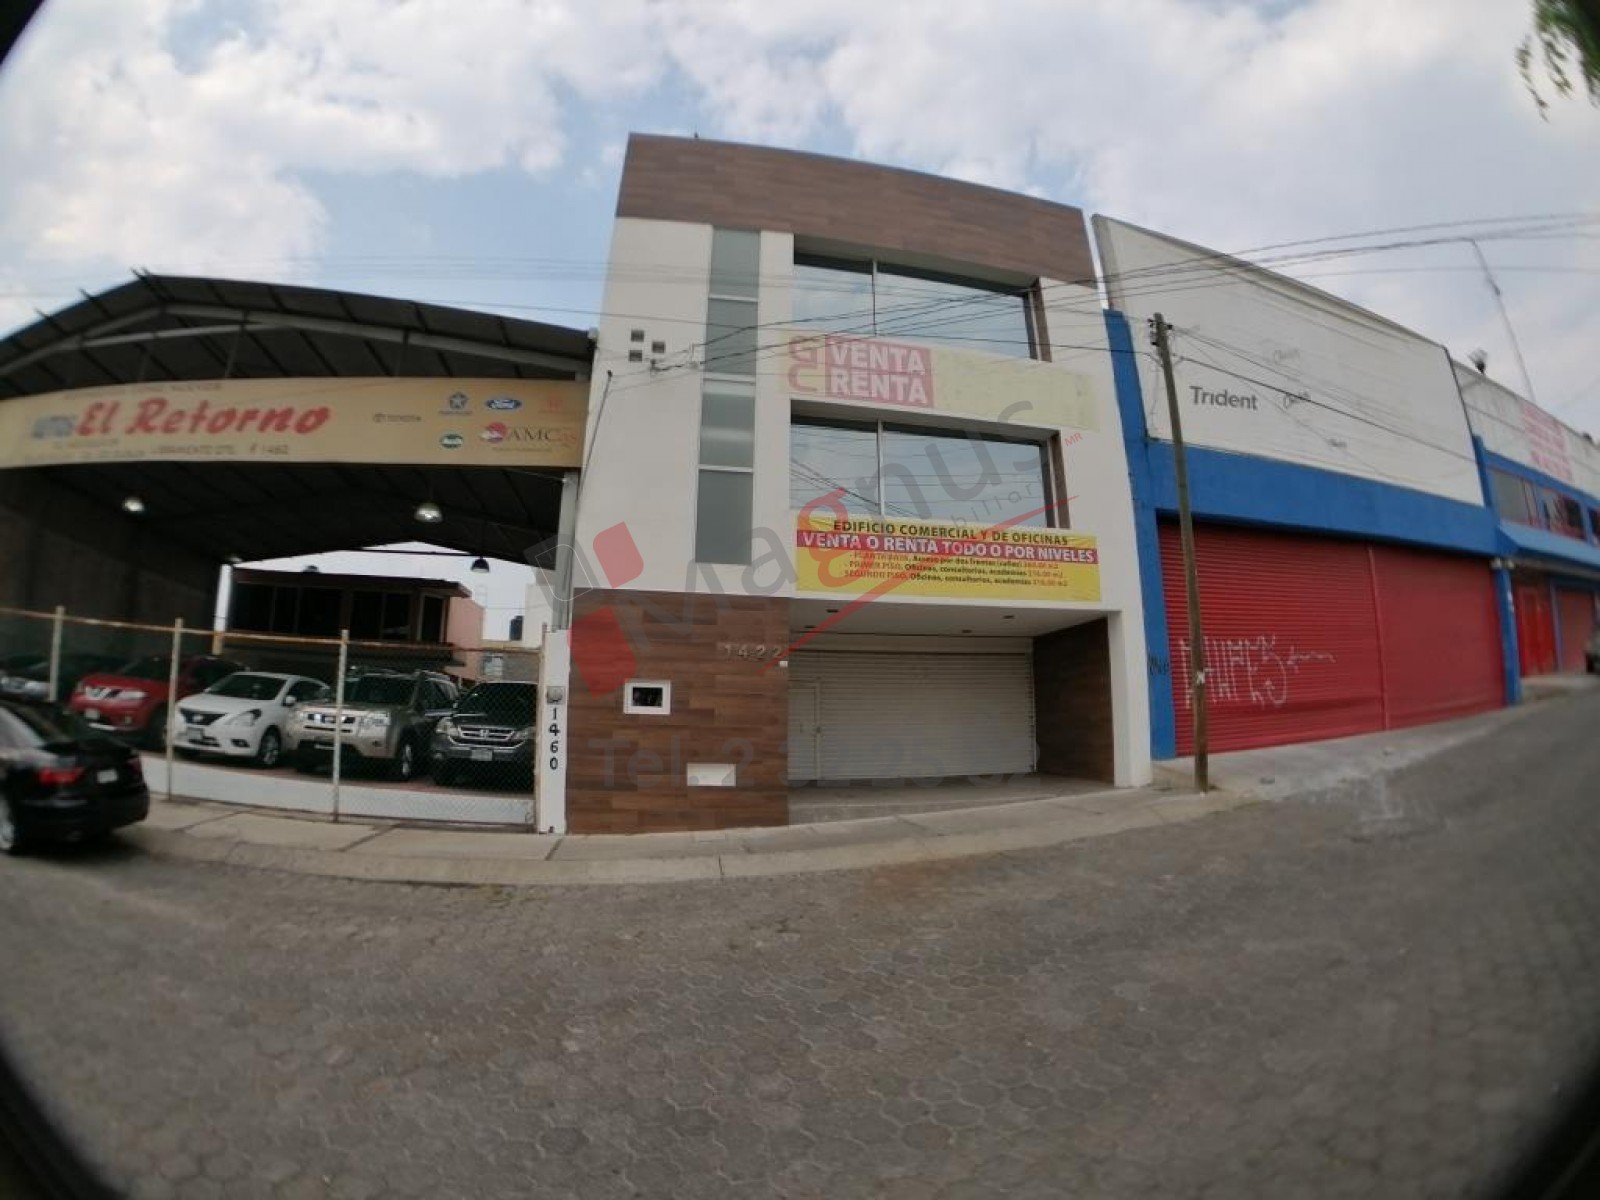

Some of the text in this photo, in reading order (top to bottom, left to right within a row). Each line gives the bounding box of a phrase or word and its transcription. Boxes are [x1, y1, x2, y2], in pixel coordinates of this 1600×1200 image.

[829, 342, 925, 375] VENTA
[829, 368, 928, 404] RENTA
[1189, 385, 1258, 411] Trident
[75, 400, 120, 437] El
[125, 397, 331, 435] Retorno
[802, 532, 1095, 562] VENTA O RENTA TODO O POR NIVELES
[833, 520, 1068, 546] EDIFICIO COMERCIAL Y DE OFICINAS
[724, 643, 782, 662] 1422
[547, 706, 561, 771] 1460
